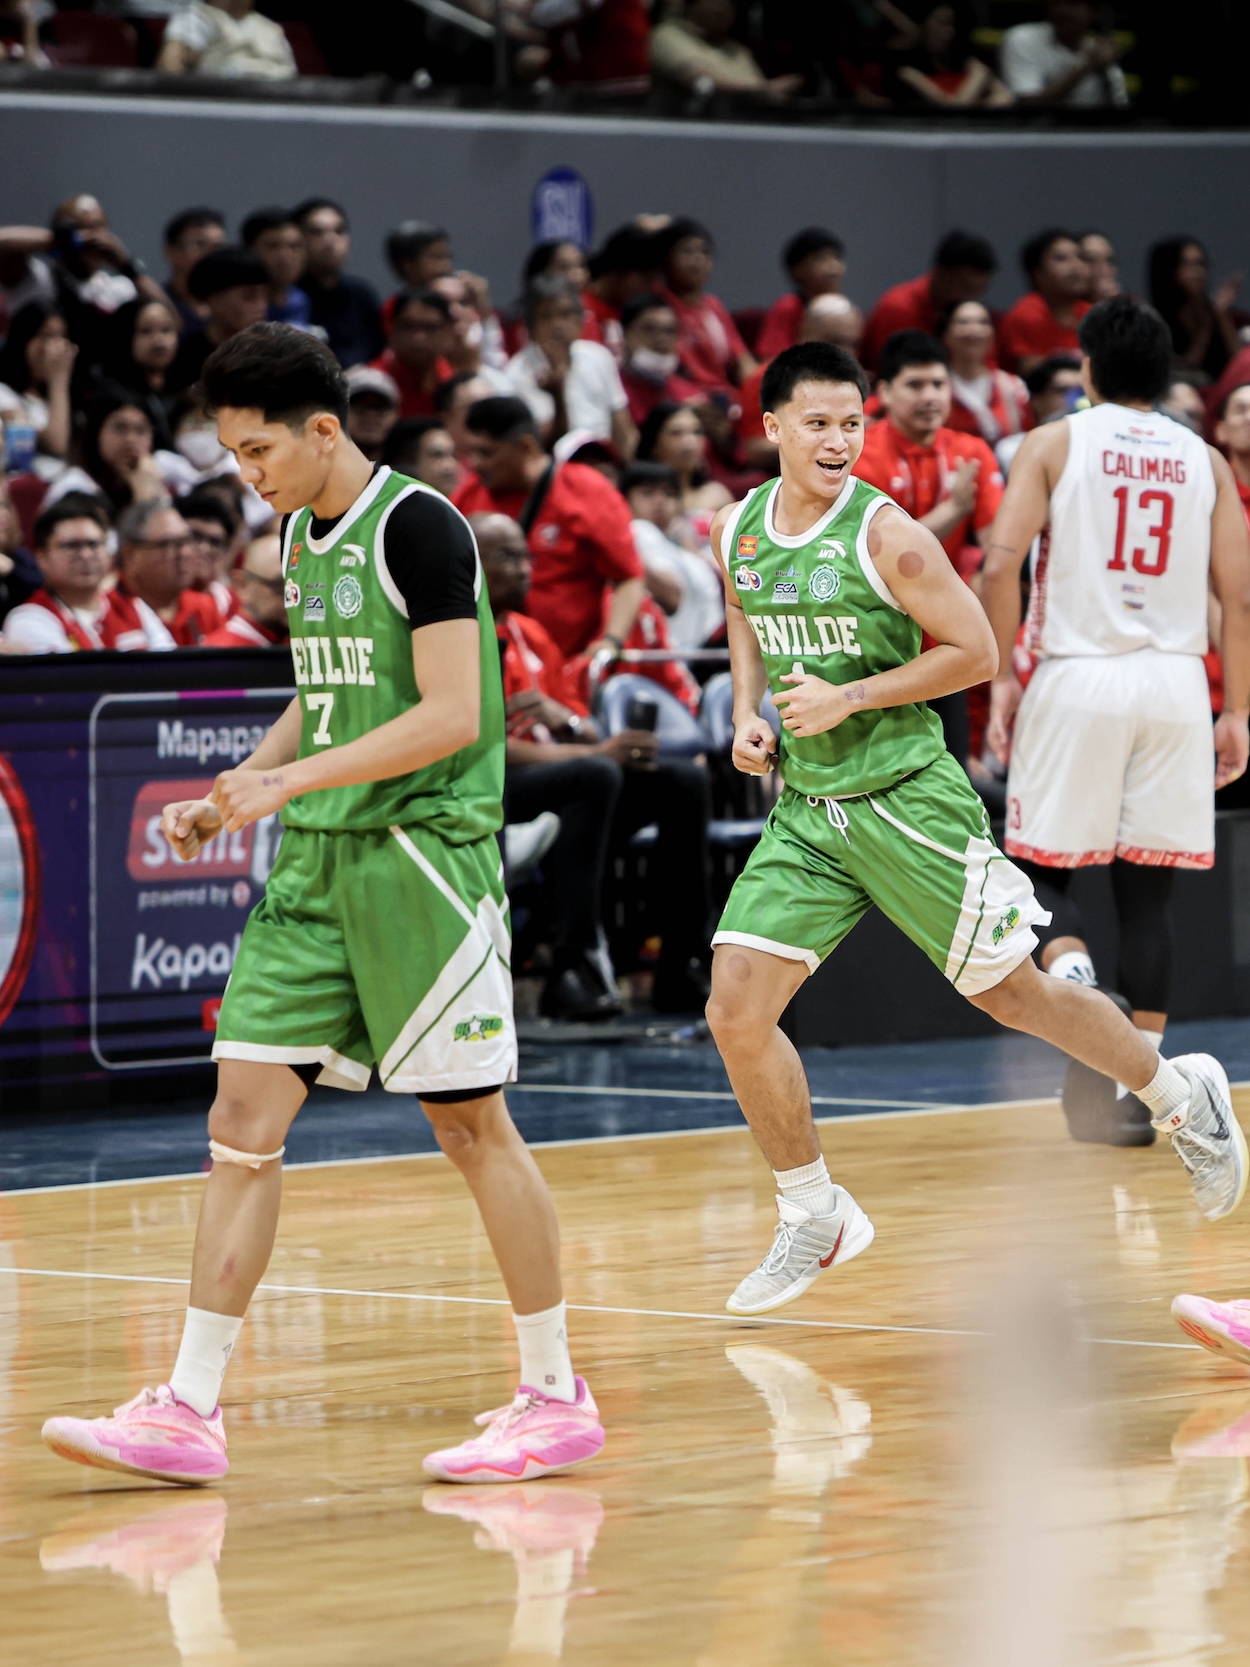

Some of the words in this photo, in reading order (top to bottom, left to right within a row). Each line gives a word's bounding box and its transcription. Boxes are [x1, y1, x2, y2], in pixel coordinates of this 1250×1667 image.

[1103, 450, 1186, 484] CALIMAG
[1107, 485, 1175, 577] 13
[818, 549, 836, 559] ANTA
[775, 583, 798, 593] SGA
[745, 615, 862, 656] ENILDE
[305, 692, 334, 745] 7
[157, 720, 273, 764] Mapapa
[137, 885, 207, 911] powered
[210, 881, 232, 908] by
